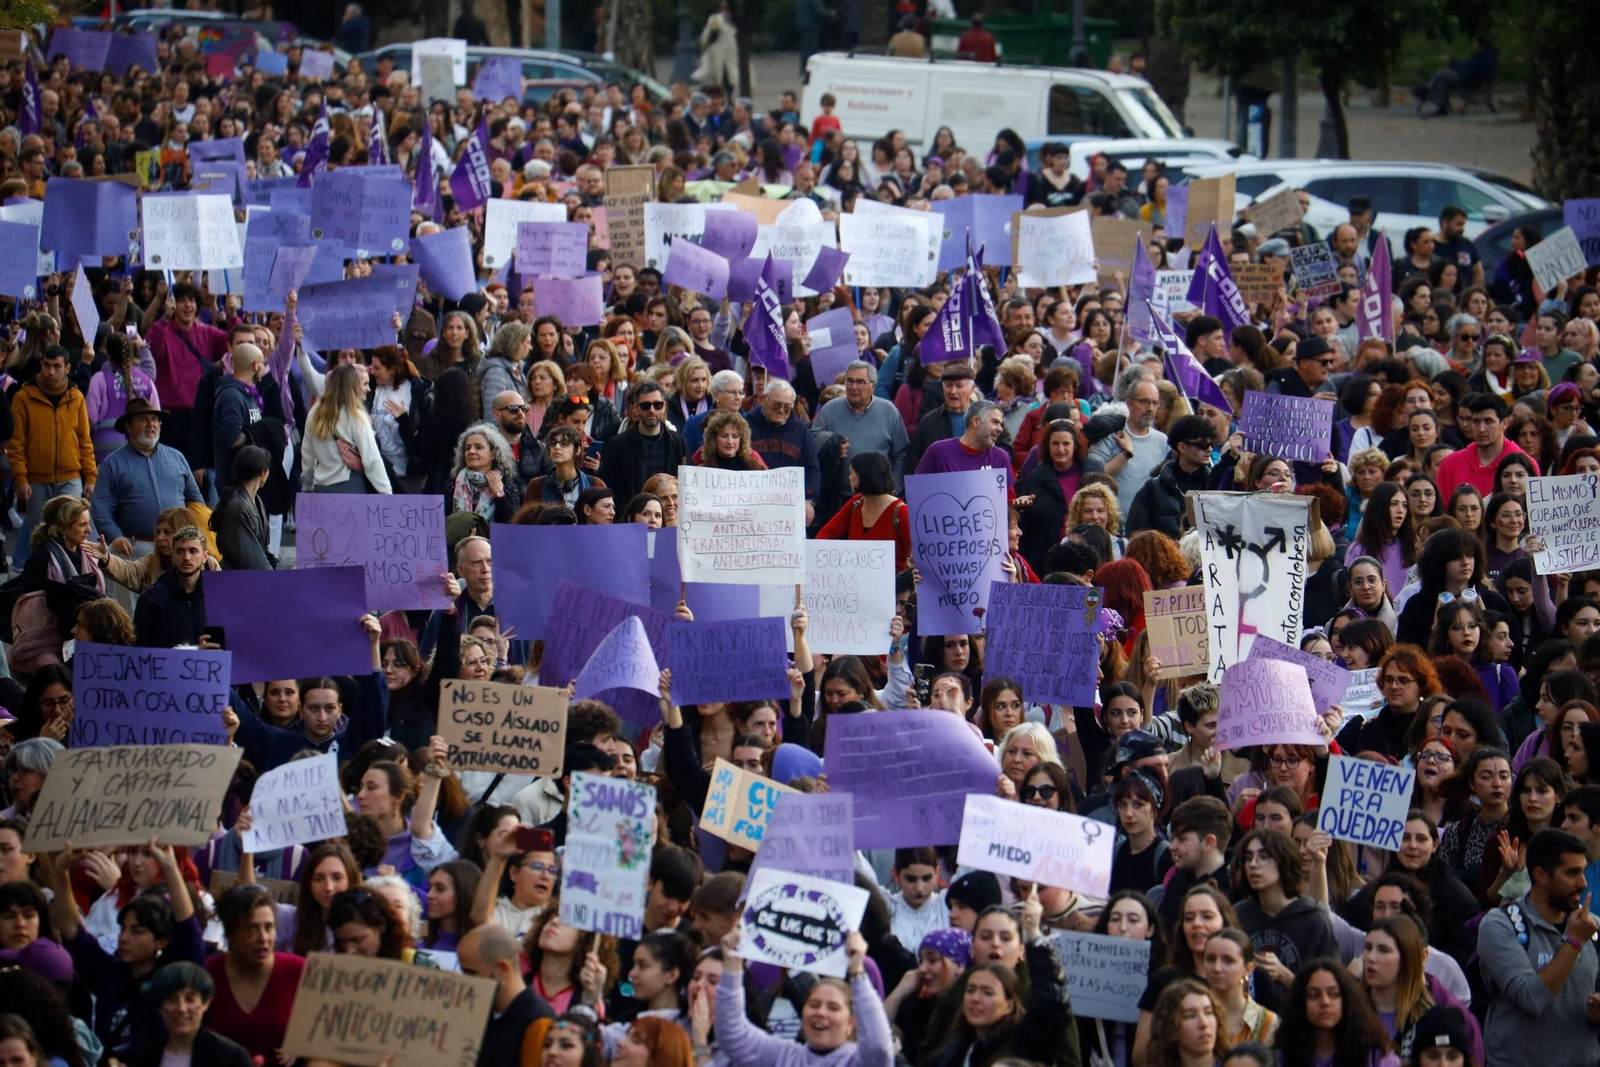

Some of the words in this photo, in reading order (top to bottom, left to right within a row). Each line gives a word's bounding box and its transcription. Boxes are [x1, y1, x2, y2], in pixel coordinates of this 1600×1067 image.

[1576, 205, 1597, 221] NO
[1291, 248, 1306, 259] SE
[1308, 245, 1320, 255] LO
[1262, 395, 1322, 411] MACHISMO
[683, 472, 698, 487] LA
[705, 473, 747, 490] LUCHA
[749, 470, 799, 490] FEMINISTA
[1529, 479, 1549, 503] EL
[684, 492, 698, 506] ES
[300, 494, 357, 527] NUNCA
[366, 504, 392, 528] ME
[397, 502, 444, 530] SENTÍ
[691, 509, 704, 520] DE
[1530, 505, 1570, 522] CUBATA
[1573, 500, 1594, 516] QUE
[922, 509, 995, 536] LIBRES
[1532, 526, 1549, 537] NOS
[373, 531, 442, 561] PORQUE
[917, 538, 1002, 561] PODEROSAS
[1541, 537, 1549, 549] A
[1555, 532, 1583, 548] ELLOS
[1586, 530, 1597, 543] LE
[815, 548, 886, 570] SOMOS
[1542, 543, 1599, 570] JUSTIFICA
[944, 579, 951, 590] Y
[952, 578, 973, 590] SIN
[938, 592, 980, 607] MIEDO
[670, 627, 698, 654] POR
[701, 627, 723, 653] UN
[725, 623, 782, 650] SISTEMA
[1279, 640, 1293, 656] YOU
[79, 646, 168, 681] DÉJAME
[178, 657, 222, 683] SER
[670, 652, 737, 674] EDUCATIVO
[741, 649, 765, 667] CON
[767, 648, 784, 663] UN
[672, 673, 724, 690] TEMARIO
[727, 671, 747, 684] QUE
[83, 686, 130, 711] OTRA
[133, 689, 181, 713] COSA
[185, 692, 226, 714] QUE
[512, 690, 533, 706] UN
[681, 691, 691, 700] EL
[741, 684, 754, 696] LA
[1234, 684, 1310, 716] MUJER
[452, 709, 495, 726] CASO
[1230, 724, 1245, 739] UN
[1248, 712, 1316, 737] CUMPLIDO
[71, 717, 98, 746] NO
[104, 722, 138, 747] SEA
[142, 725, 168, 746] UN
[462, 730, 483, 743] SE
[491, 730, 543, 752] LLAMA
[70, 776, 84, 796] Y
[1340, 760, 1411, 796] VEÑEN
[581, 782, 647, 818] SOMOS
[1339, 788, 1383, 814] PRA
[31, 797, 128, 841] ALIANZA
[1321, 806, 1404, 849] QUEDAR
[804, 836, 817, 858] Y
[987, 841, 1032, 865] MIEDO
[573, 903, 589, 926] NO
[758, 910, 778, 927] DE
[780, 914, 802, 934] LAS
[803, 923, 824, 943] QUE
[826, 928, 841, 943] YA
[1061, 953, 1092, 968] USTAN
[1134, 948, 1149, 960] ME
[1079, 976, 1100, 993] LAS
[1102, 981, 1142, 998] ACOSO
[307, 1000, 450, 1053] ANTICOLONIAL
